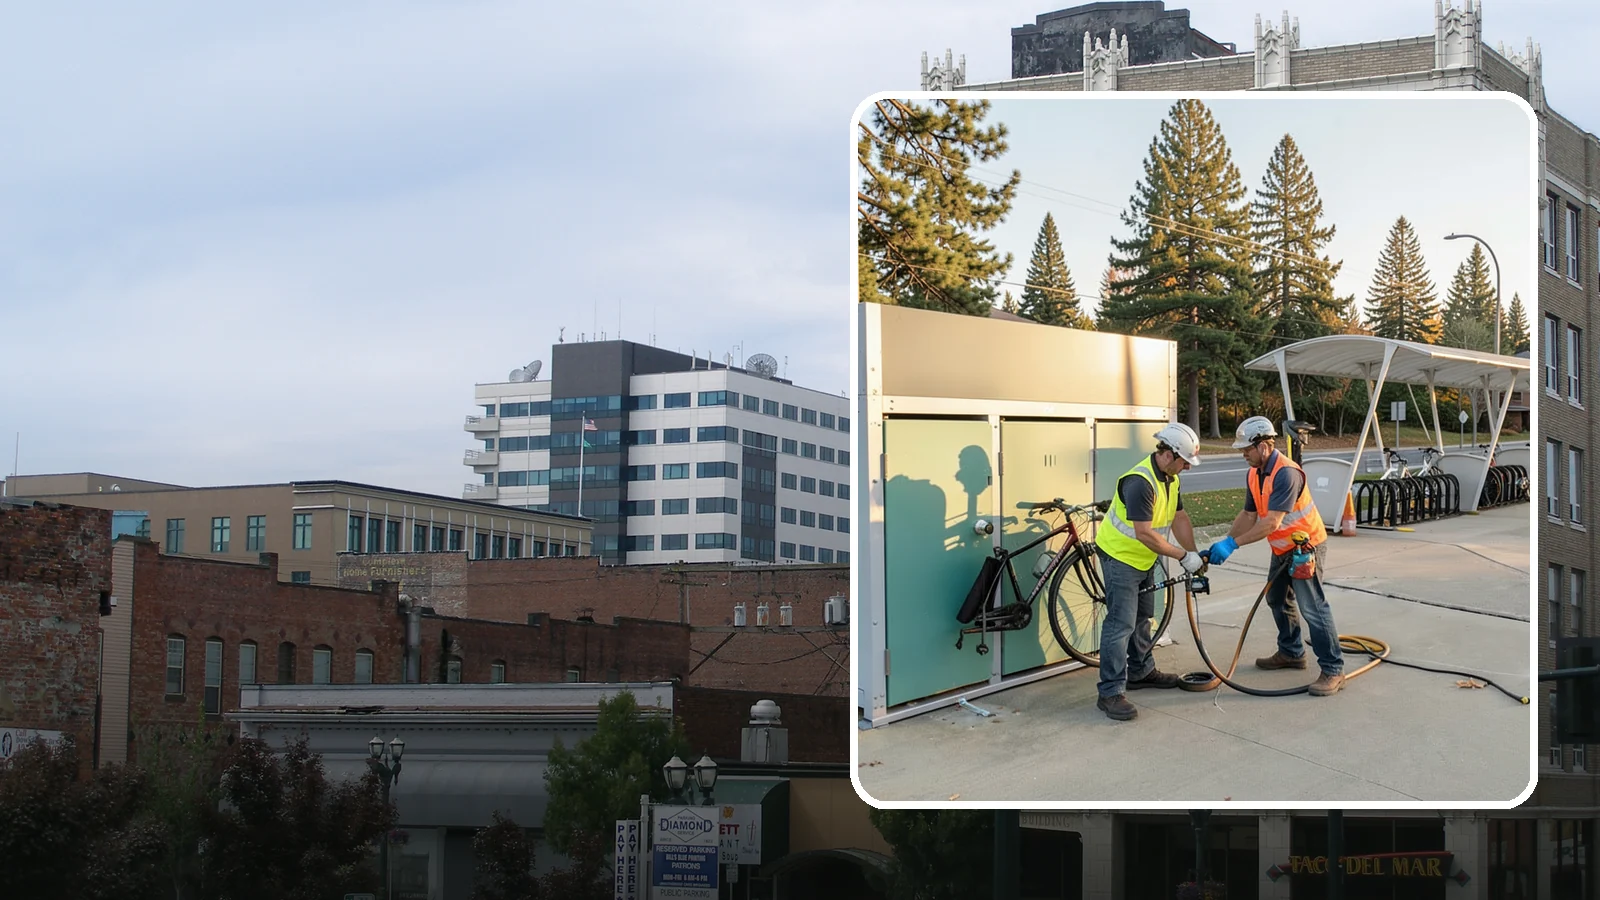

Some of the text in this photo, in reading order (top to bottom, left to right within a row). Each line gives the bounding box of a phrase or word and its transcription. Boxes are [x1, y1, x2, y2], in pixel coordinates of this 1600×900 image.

[343, 566, 427, 577] Home Furnishers
[660, 818, 713, 833] DIAMOND
[1022, 815, 1070, 828] BUILDING
[617, 825, 626, 893] PAY HERE
[628, 825, 637, 893] PAY HERE
[722, 852, 739, 862] Soup
[1346, 856, 1384, 875] DEL
[1392, 857, 1443, 877] MAR
[660, 889, 712, 898] PUBLIC PARKING
